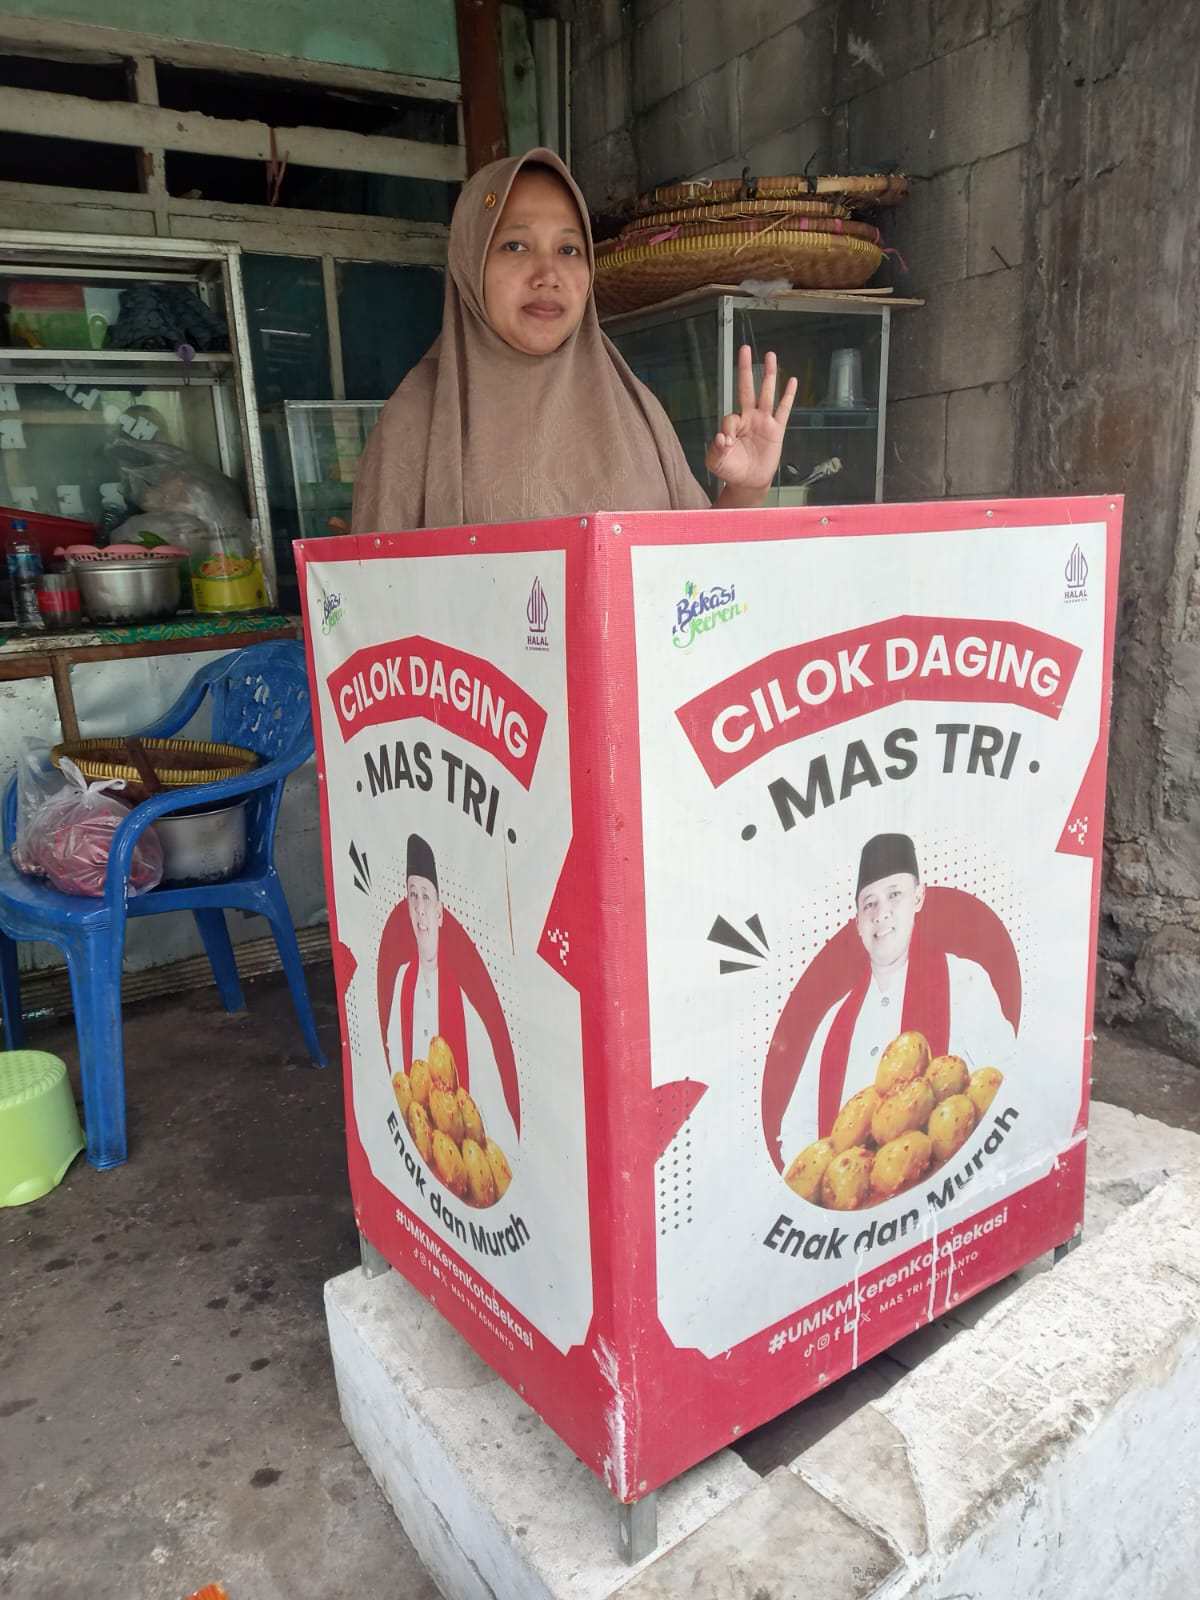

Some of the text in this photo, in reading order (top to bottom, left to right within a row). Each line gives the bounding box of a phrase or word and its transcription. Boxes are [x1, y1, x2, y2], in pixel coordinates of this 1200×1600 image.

[527, 636, 549, 646] HALAL
[673, 584, 736, 632] Bekasi
[1064, 590, 1088, 599] HALAL
[339, 655, 530, 759] CILOK DAGING
[711, 634, 1062, 754] CILOK DAGING
[363, 741, 500, 838] MAS TRI
[767, 722, 1023, 833] MAS TRI
[386, 1110, 531, 1257] Enak dan Murah
[762, 1106, 1020, 1261] Enak dan Murah
[394, 1207, 534, 1352] #UMKMKerenKotaBekasi
[879, 1293, 905, 1314] MAS
[906, 1281, 924, 1298] TRI
